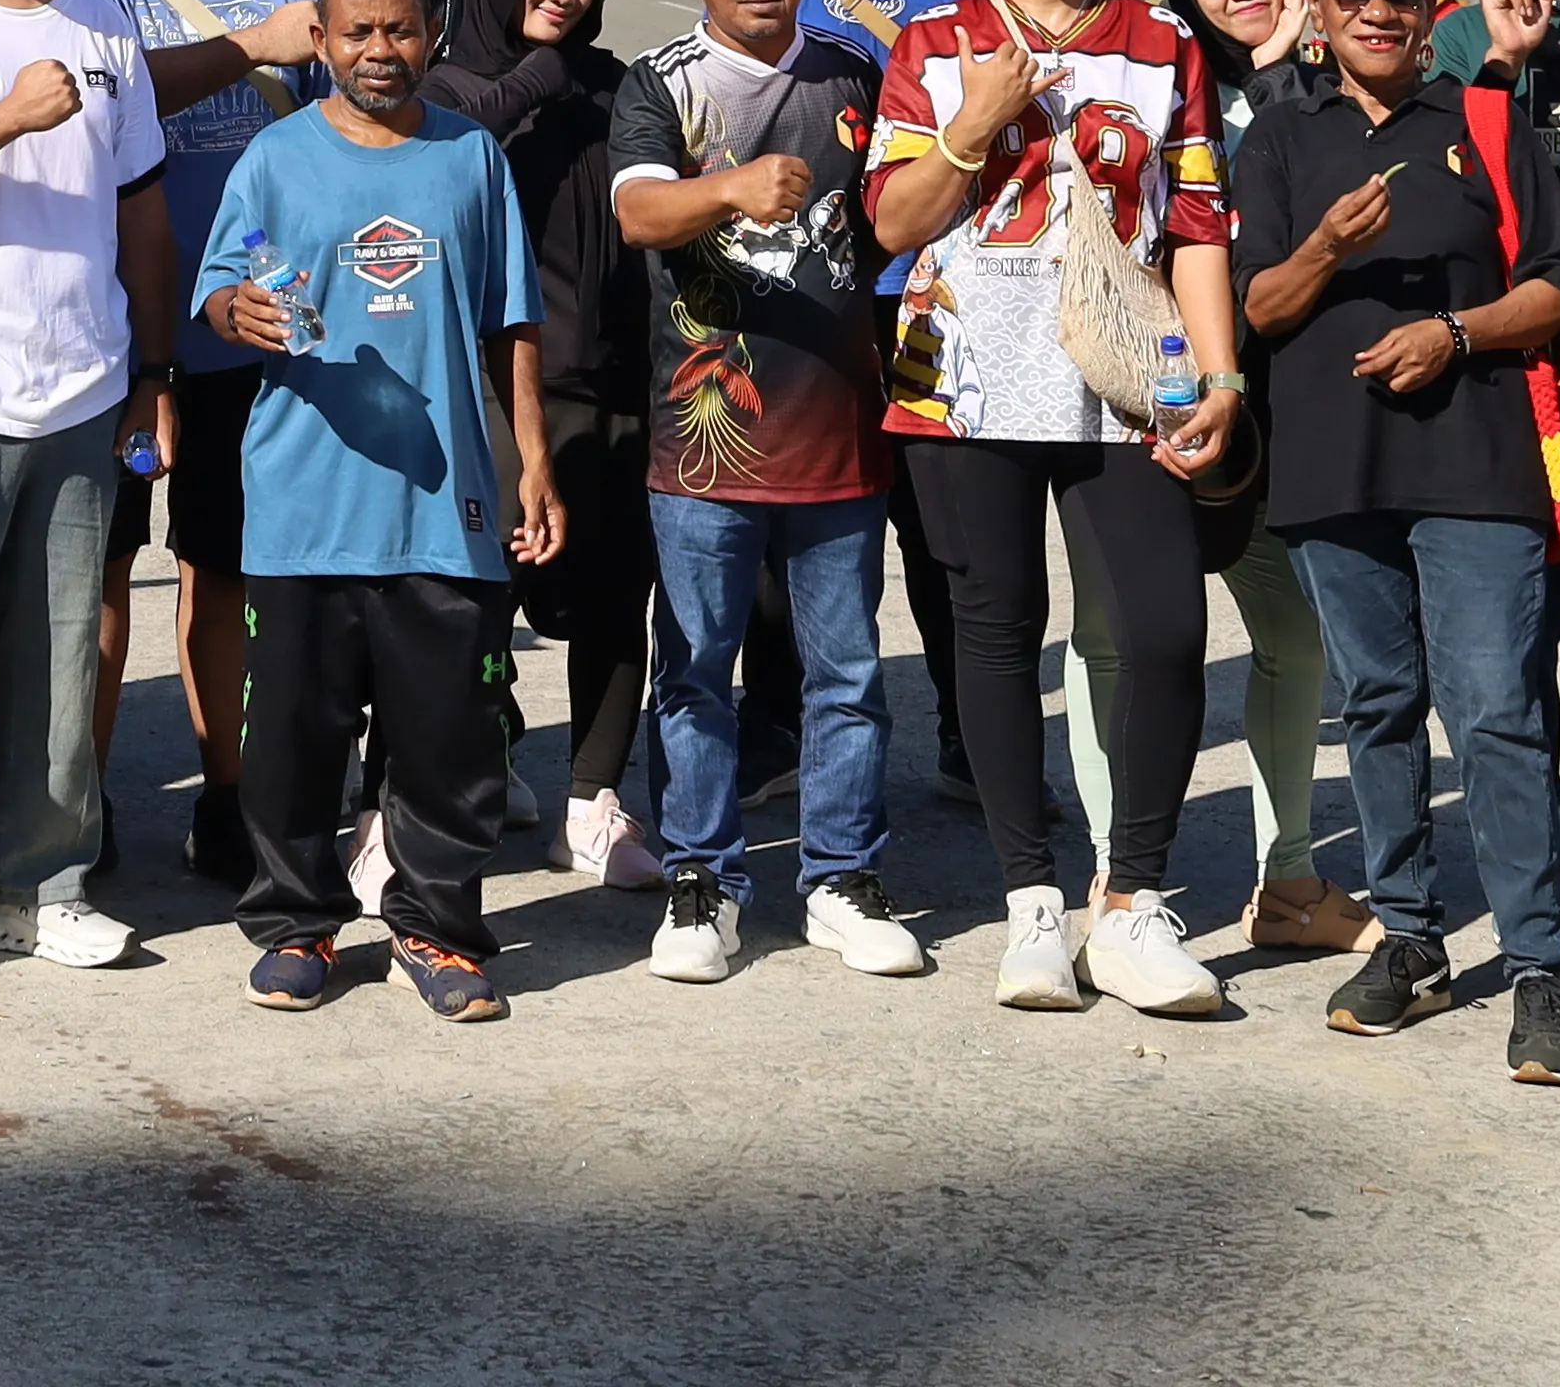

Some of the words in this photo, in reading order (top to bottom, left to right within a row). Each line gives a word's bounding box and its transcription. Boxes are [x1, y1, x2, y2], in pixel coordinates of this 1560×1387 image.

[353, 247, 379, 260] RAW
[388, 244, 424, 258] DENIM
[976, 257, 1041, 277] MONKEY
[396, 300, 415, 312] STYLE
